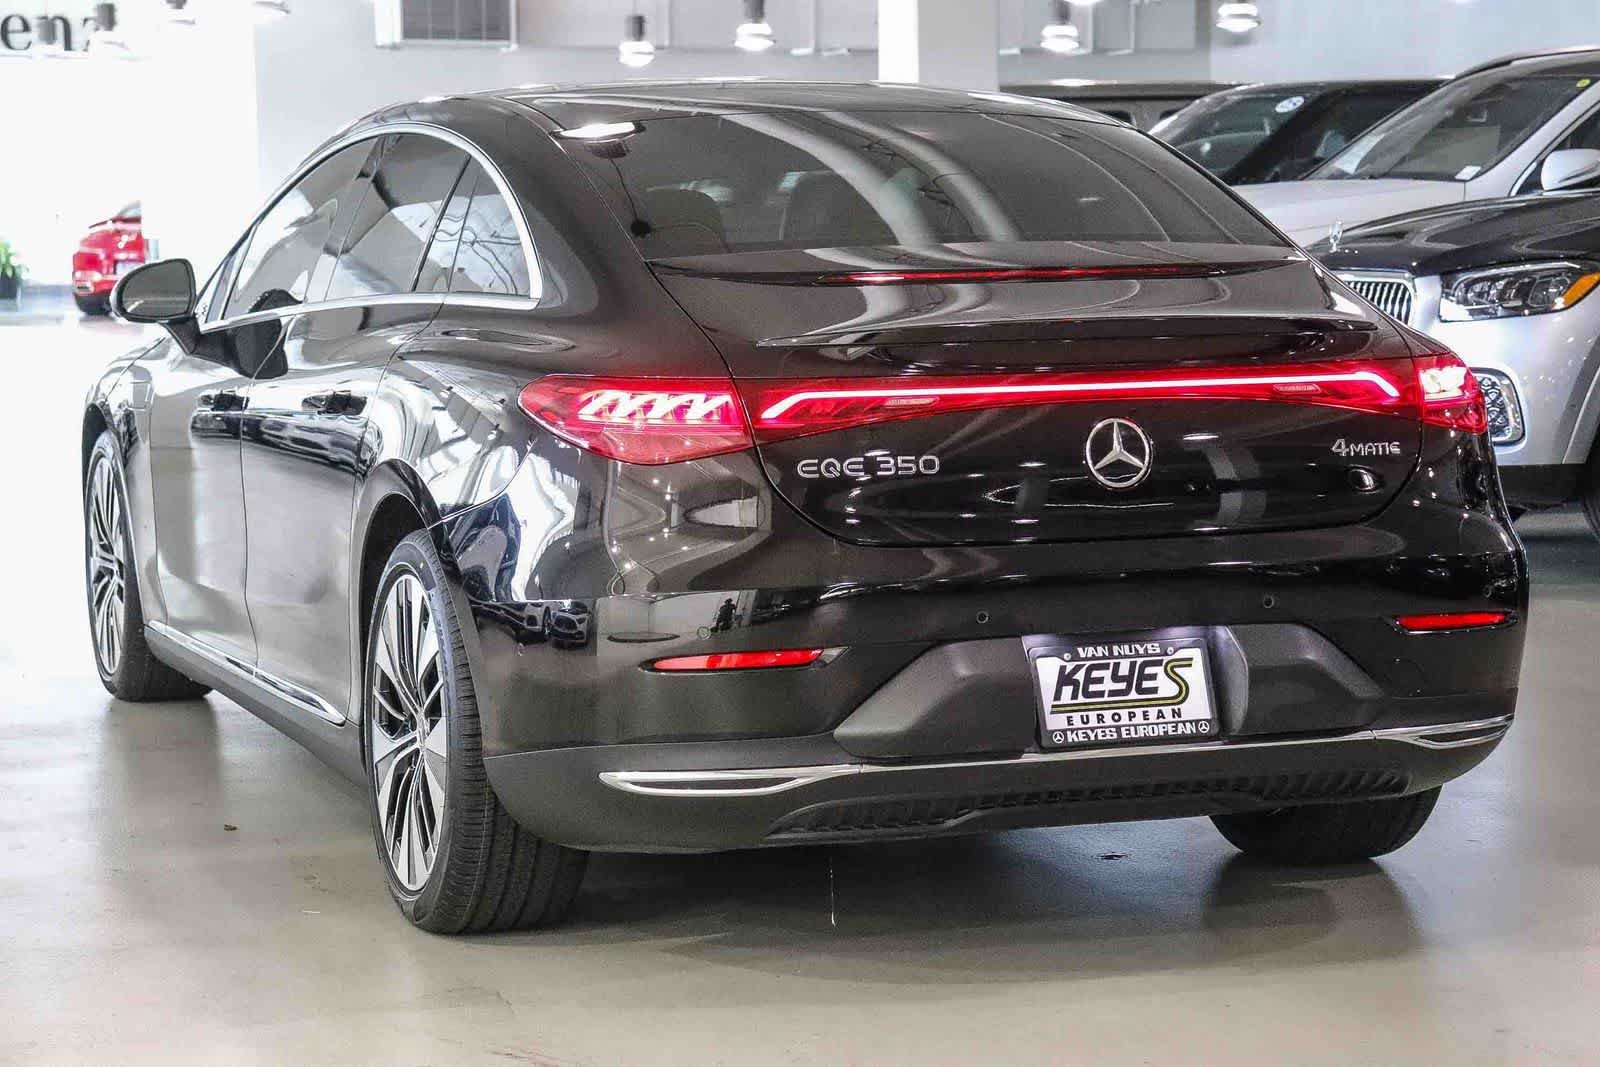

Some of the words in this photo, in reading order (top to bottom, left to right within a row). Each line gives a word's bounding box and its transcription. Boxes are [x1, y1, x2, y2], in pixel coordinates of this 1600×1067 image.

[797, 458, 865, 478] EQE
[876, 455, 940, 475] 350
[1077, 646, 1108, 658] VAN
[1113, 643, 1160, 656] NUYS
[1053, 657, 1193, 703] KEYES
[1066, 707, 1182, 726] EUROPEAN
[1066, 727, 1117, 743] KEYES
[1121, 721, 1196, 738] EUROPEAN
